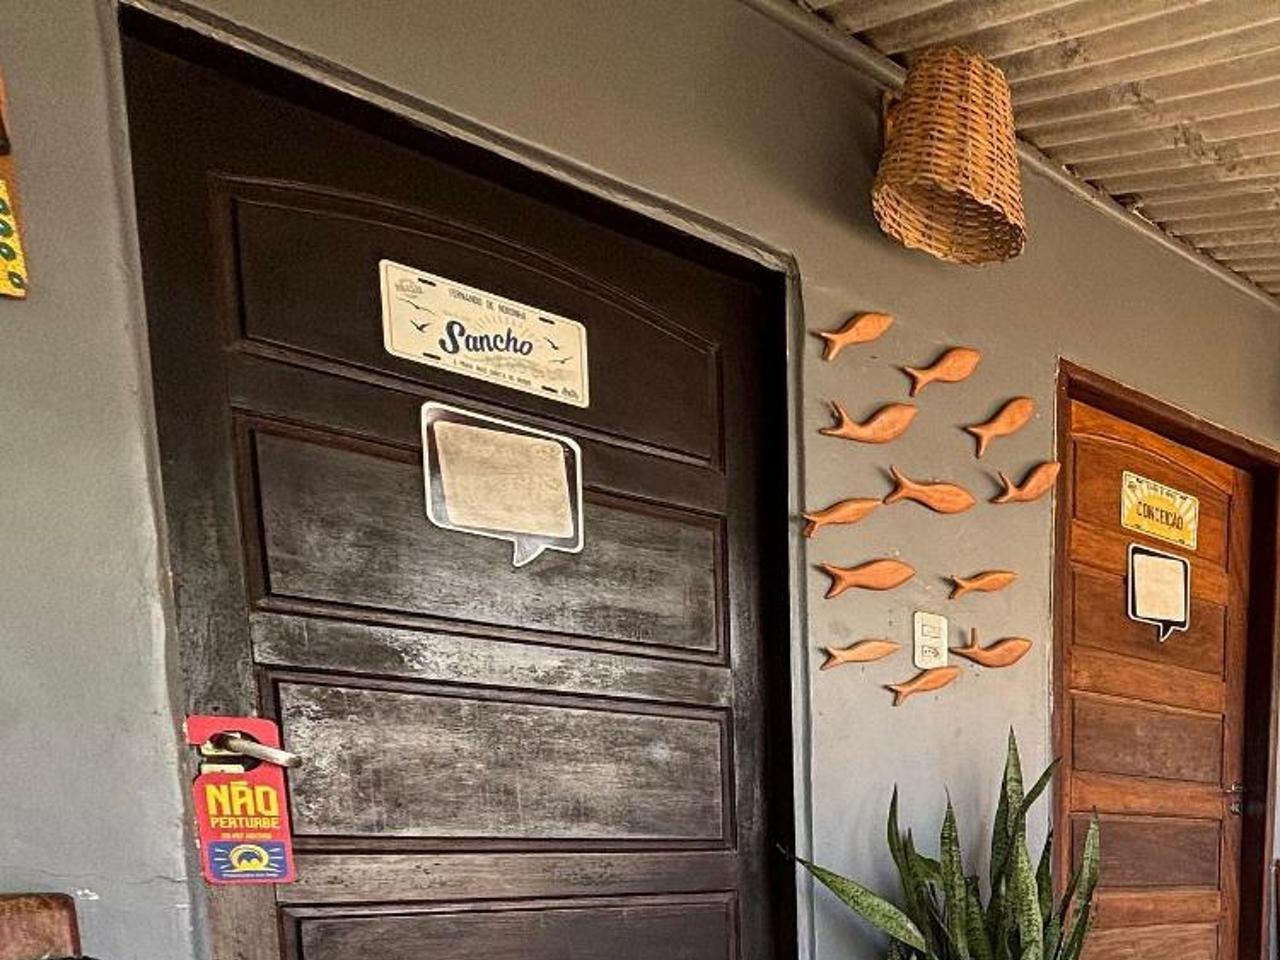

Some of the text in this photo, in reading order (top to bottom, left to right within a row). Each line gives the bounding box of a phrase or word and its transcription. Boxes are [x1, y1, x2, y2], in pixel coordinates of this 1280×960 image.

[438, 320, 534, 356] Sancho
[205, 781, 279, 817] NÃO
[210, 816, 281, 829] PERTURBE
